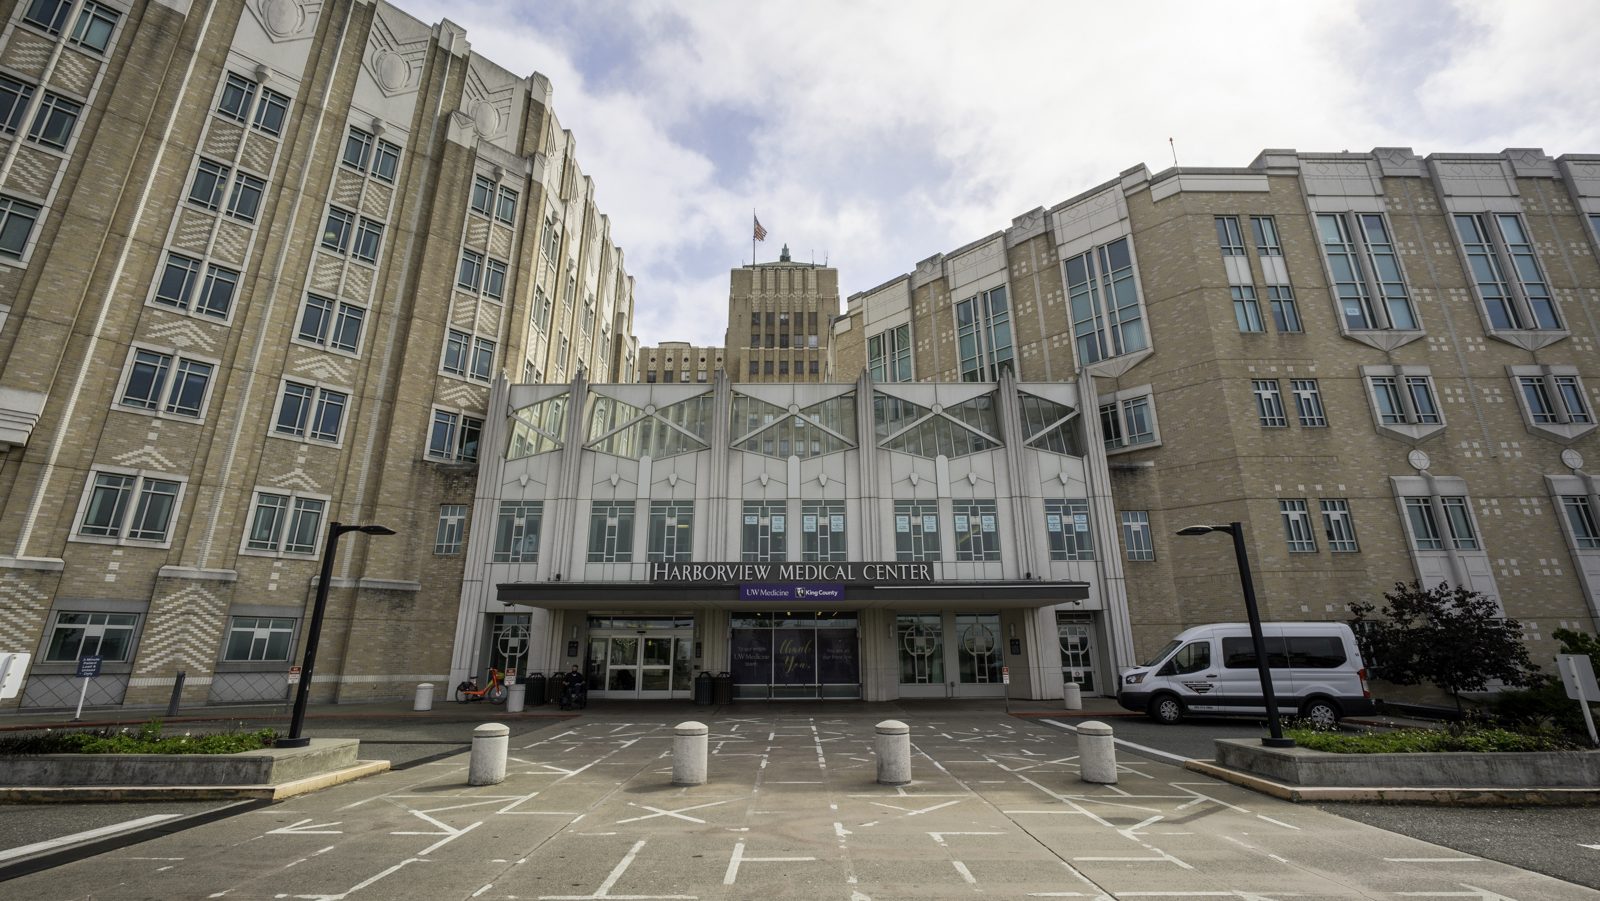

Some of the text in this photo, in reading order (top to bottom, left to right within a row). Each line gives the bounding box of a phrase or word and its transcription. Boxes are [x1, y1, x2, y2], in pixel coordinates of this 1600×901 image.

[653, 562, 931, 581] HARBORVIEW MEDICAL CENTER
[805, 589, 838, 597] King County
